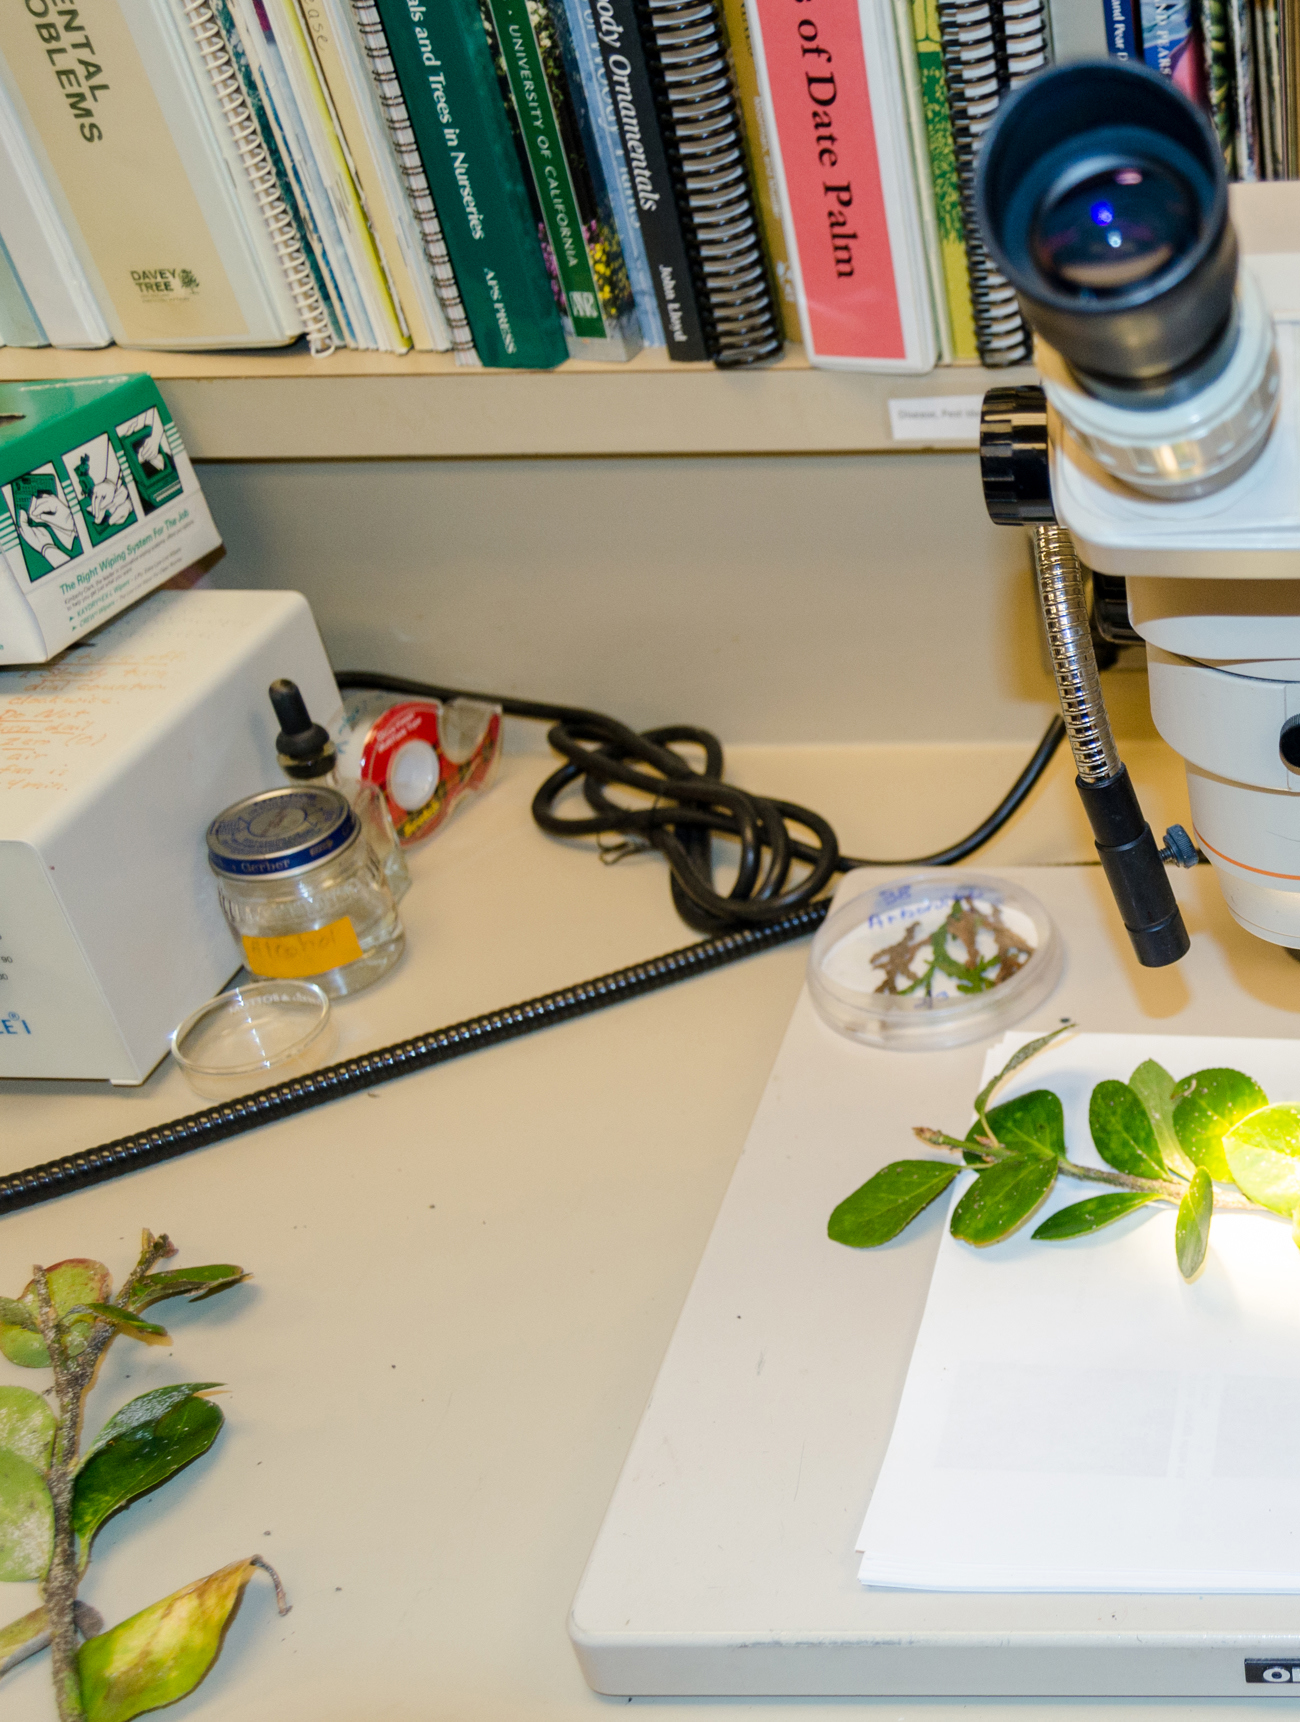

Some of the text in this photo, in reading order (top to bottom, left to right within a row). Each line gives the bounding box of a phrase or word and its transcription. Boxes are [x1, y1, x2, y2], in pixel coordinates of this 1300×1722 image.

[305, 0, 328, 51] ase
[415, 26, 442, 66] and
[596, 0, 624, 48] ody
[53, 0, 110, 102] NTAL
[1156, 30, 1172, 75] PEARS
[428, 72, 452, 124] Trees
[443, 128, 460, 147] in
[509, 25, 578, 267] UNIVERSITY OF CALIFORNIA
[608, 54, 661, 212] Ornamentals
[797, 18, 859, 279] of Date Palm
[450, 152, 485, 241] Nurseries
[130, 268, 177, 281] DAVEY
[135, 281, 175, 293] TREE
[493, 303, 518, 354] PRESS
[59, 581, 77, 595] The
[76, 567, 98, 586] Right
[98, 551, 127, 572] Wiping
[126, 534, 154, 556] System
[152, 526, 165, 540] For
[164, 517, 178, 531] The
[240, 858, 291, 873] Gerber
